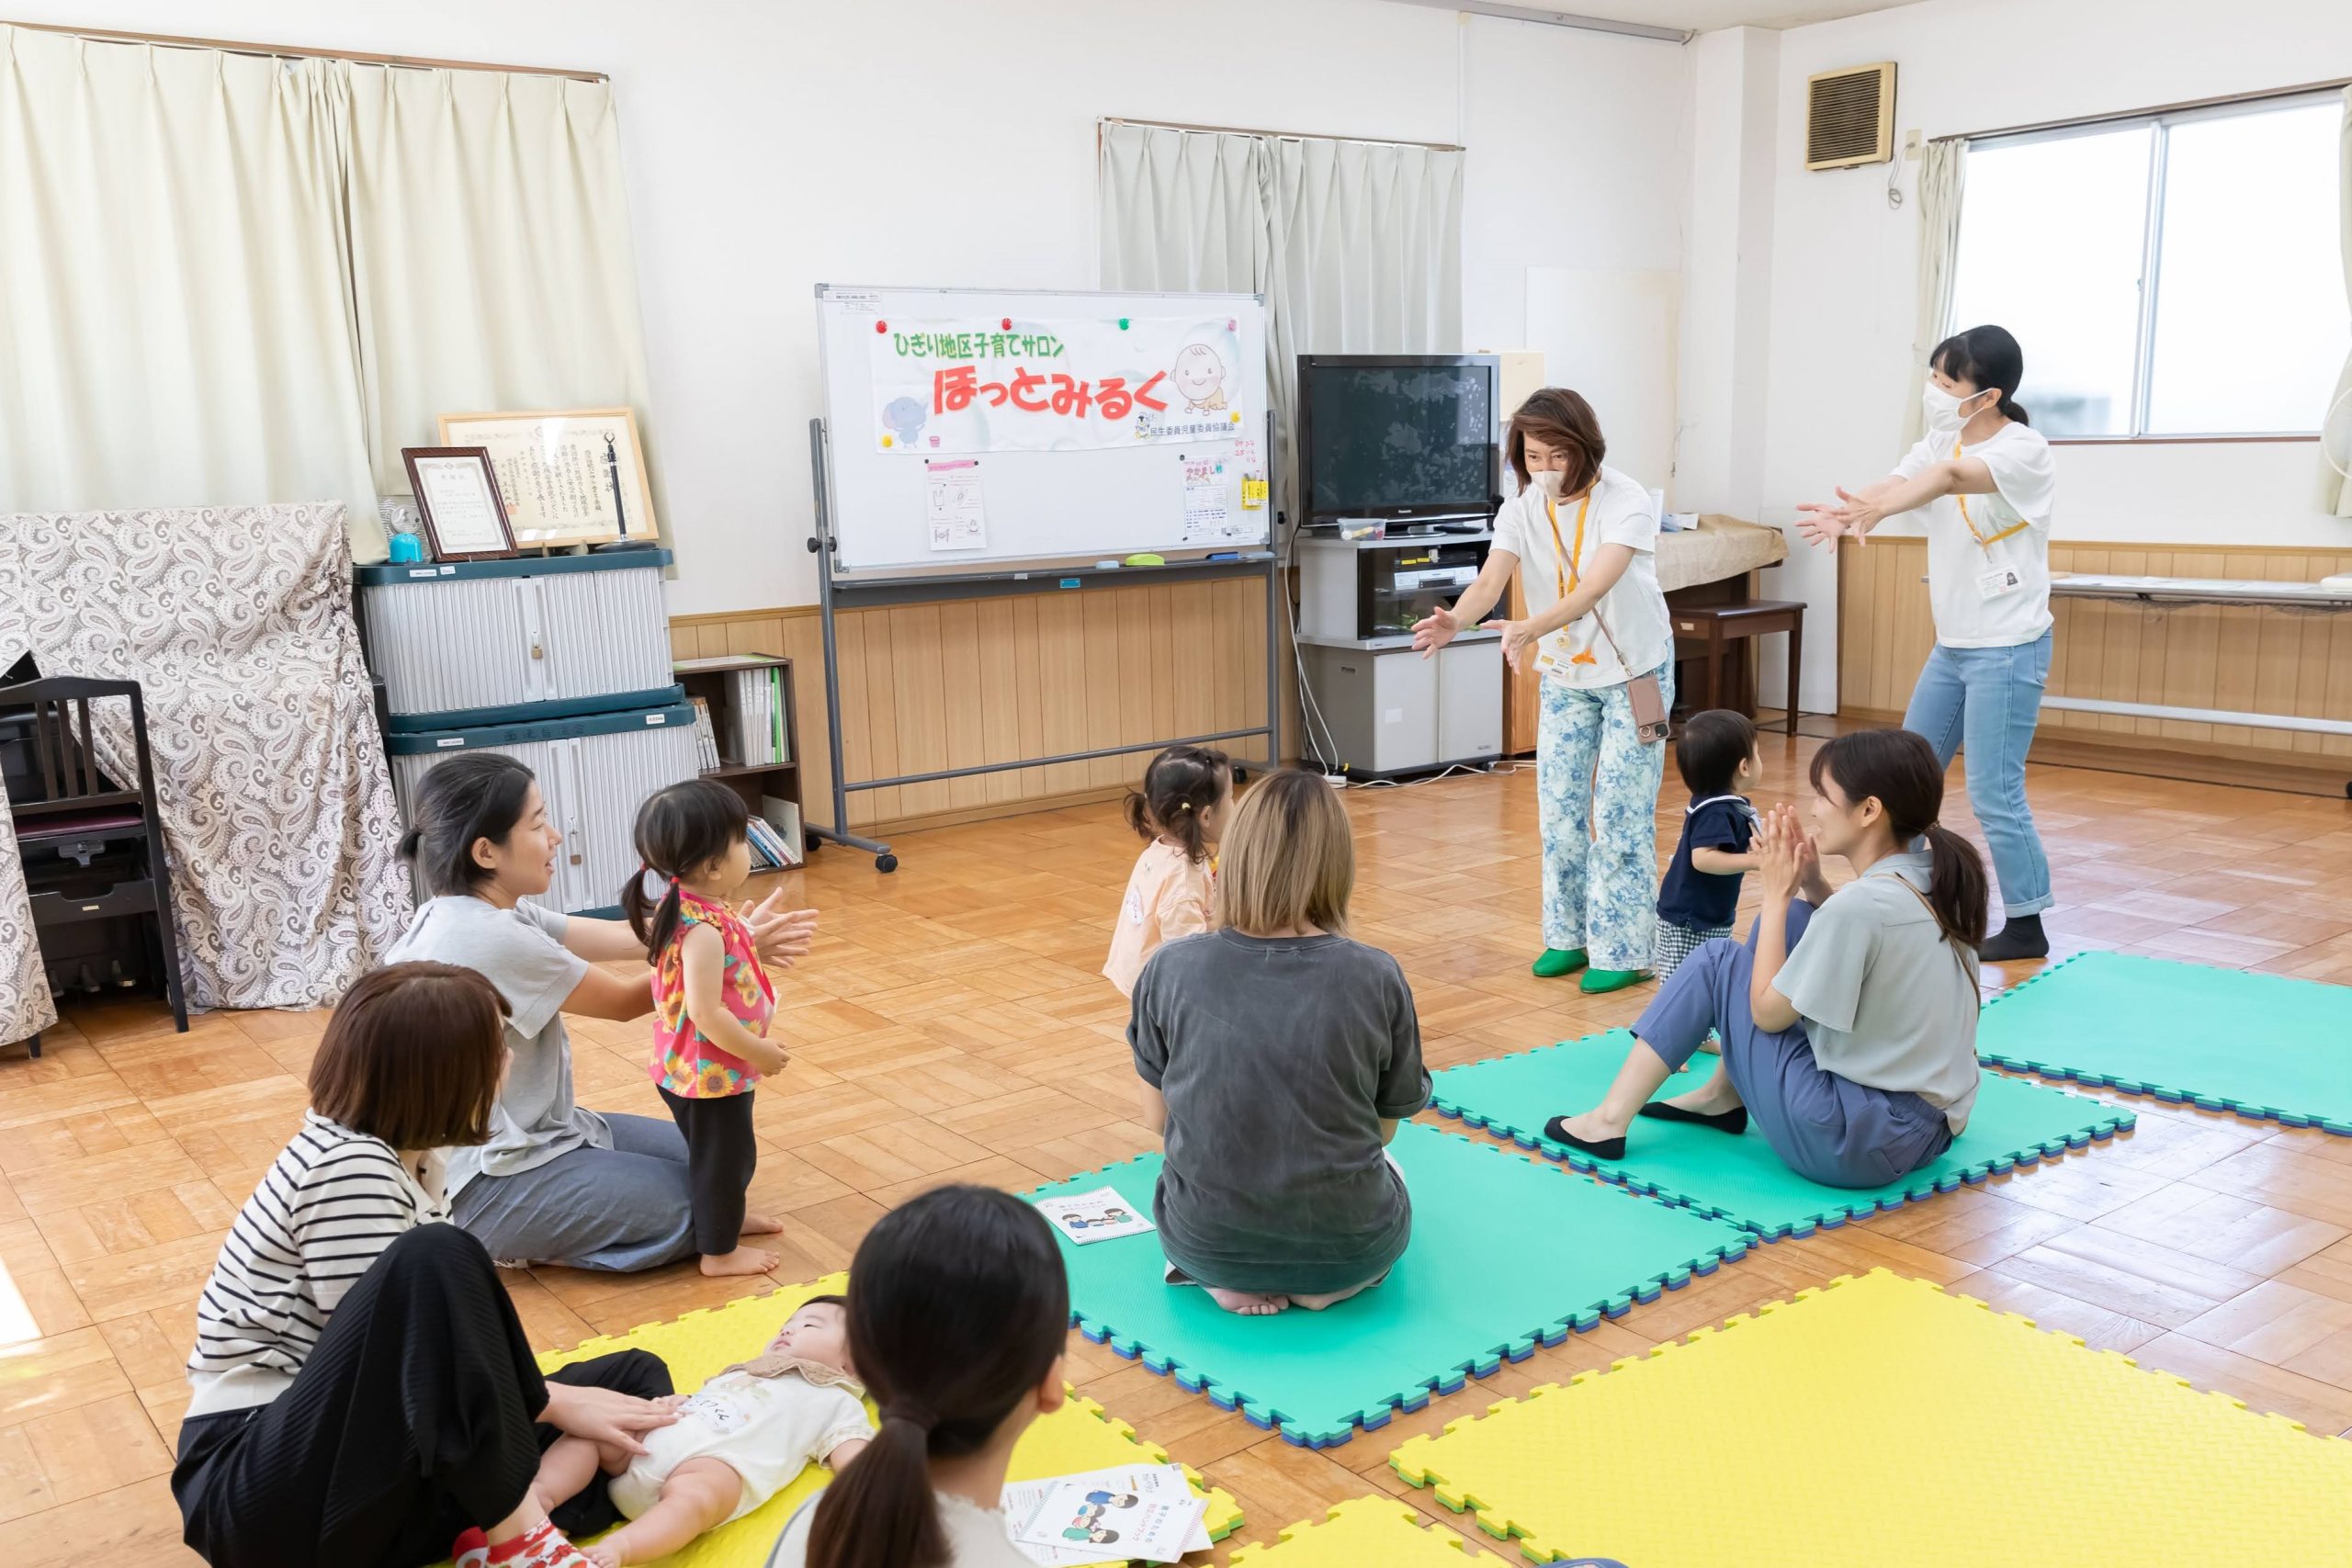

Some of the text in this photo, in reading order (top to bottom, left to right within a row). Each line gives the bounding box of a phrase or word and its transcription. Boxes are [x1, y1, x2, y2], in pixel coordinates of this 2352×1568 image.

[893, 332, 1065, 359] ひぎり地区子育てサロン
[933, 365, 1169, 421] ほっとみるく
[1150, 422, 1235, 436] 民生委員児童委員協議会
